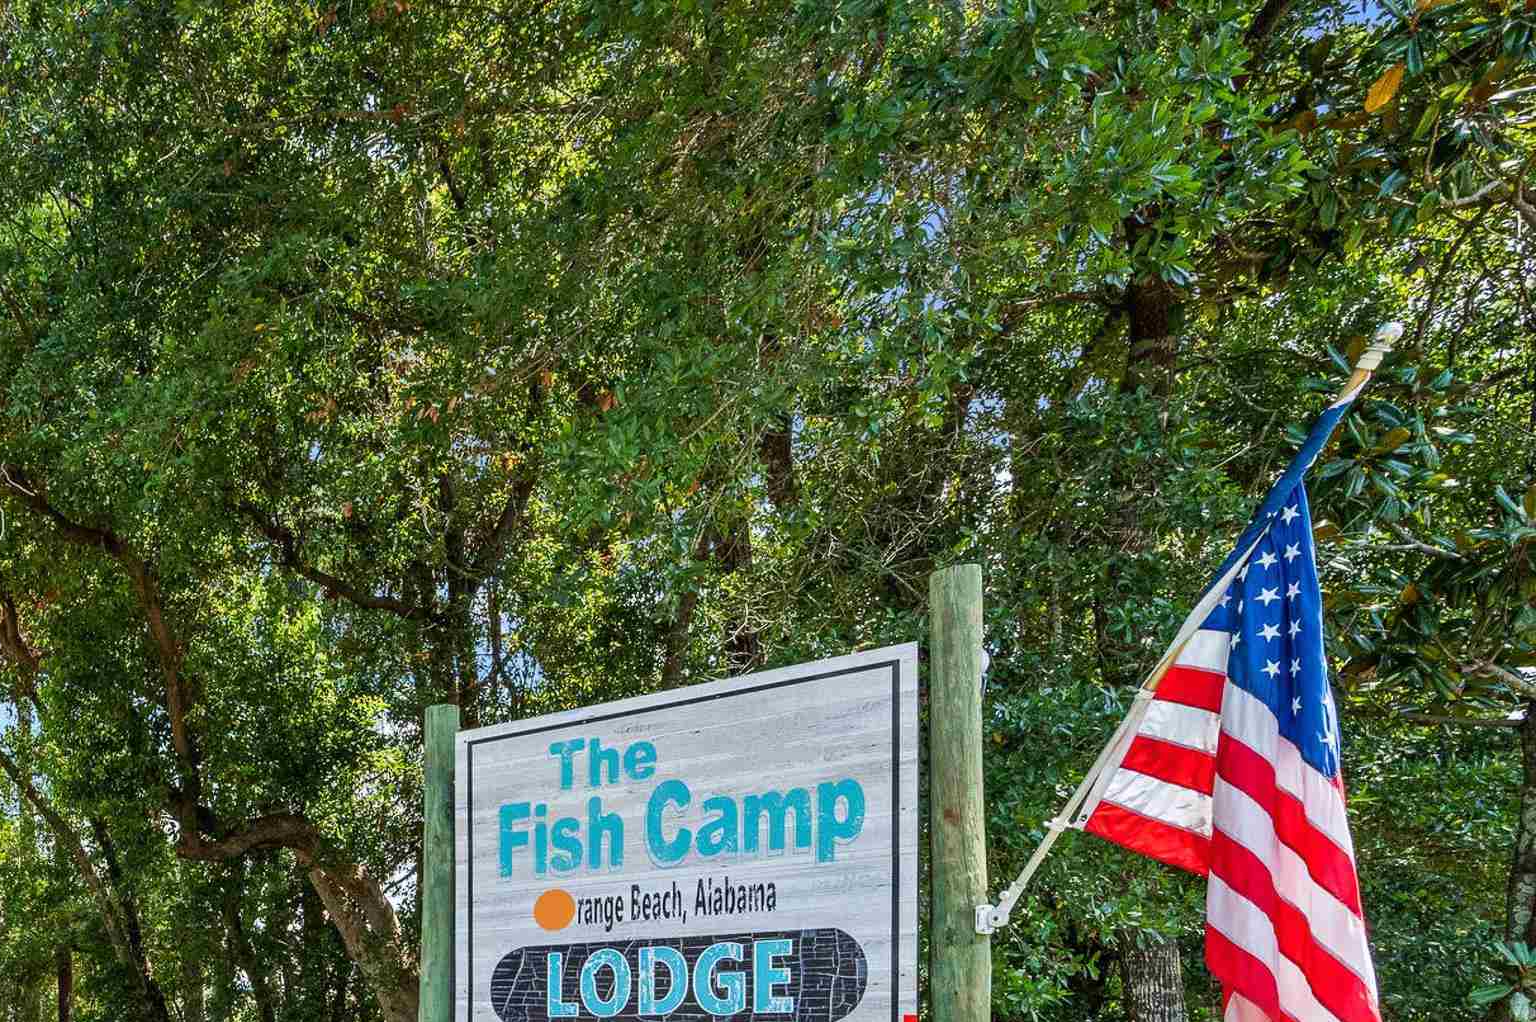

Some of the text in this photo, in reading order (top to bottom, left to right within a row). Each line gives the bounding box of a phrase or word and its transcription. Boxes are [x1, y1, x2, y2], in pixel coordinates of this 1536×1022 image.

[546, 736, 658, 792] The
[498, 777, 866, 878] Fish Camp
[631, 884, 688, 923] Beach,
[694, 877, 778, 916] Alabama
[547, 938, 795, 1018] LODGE
